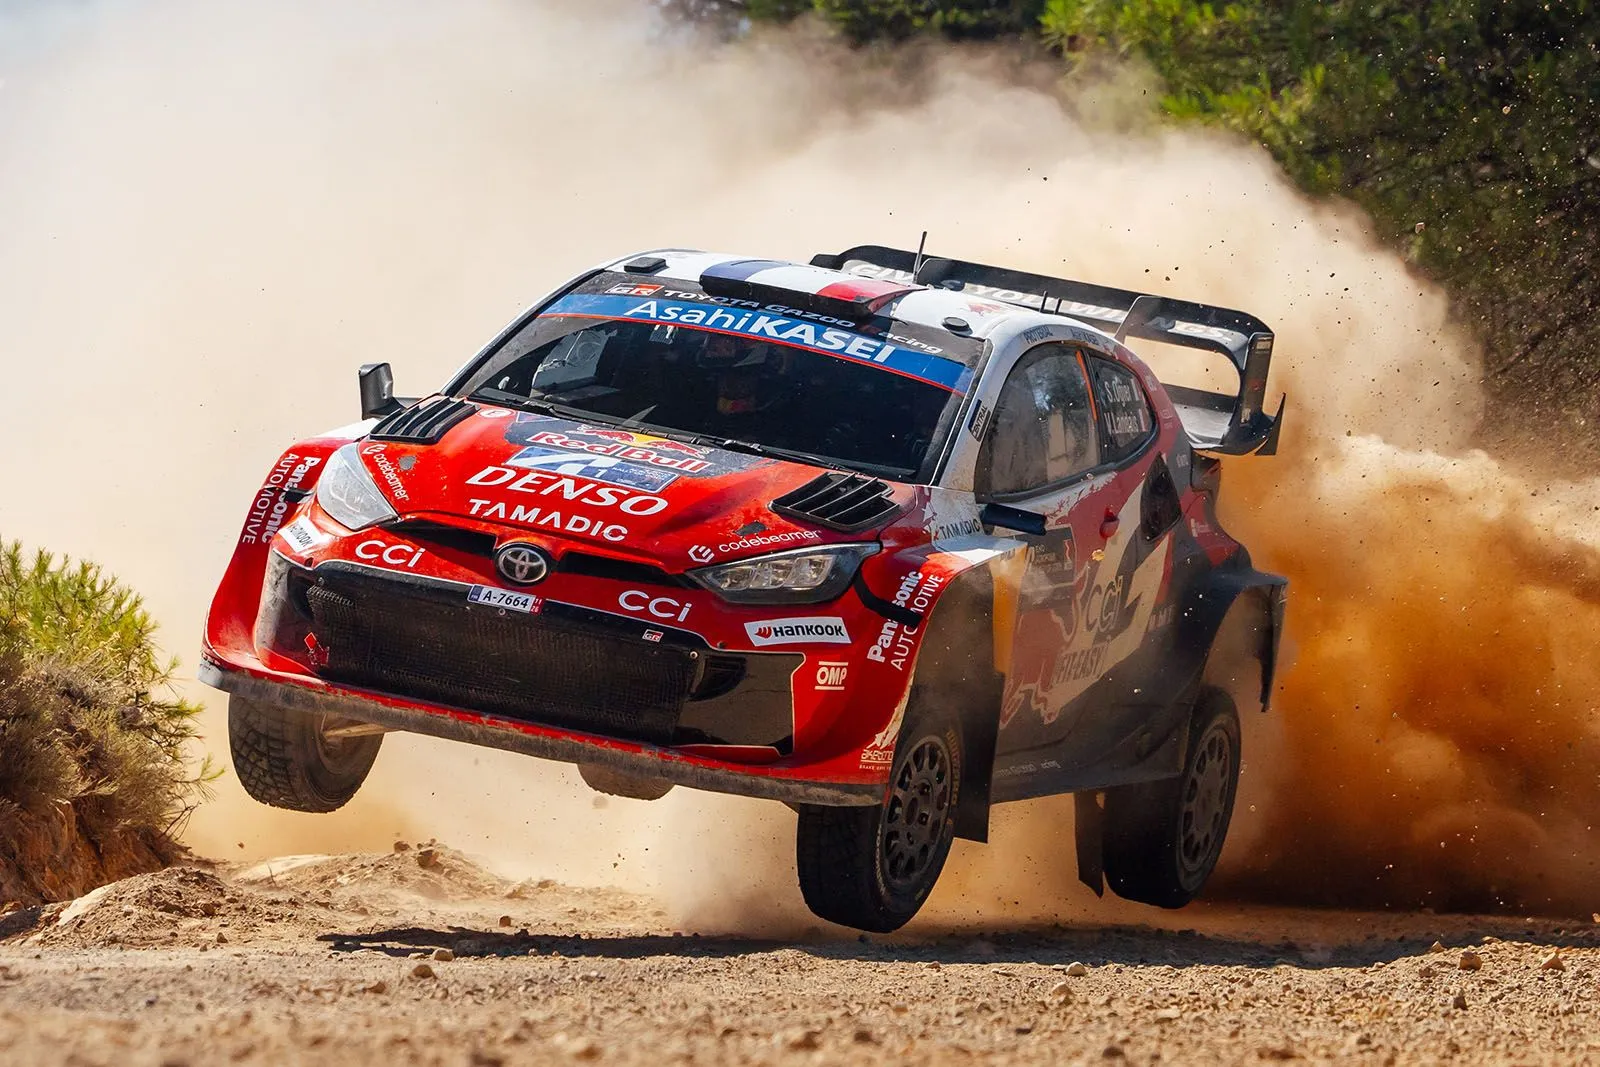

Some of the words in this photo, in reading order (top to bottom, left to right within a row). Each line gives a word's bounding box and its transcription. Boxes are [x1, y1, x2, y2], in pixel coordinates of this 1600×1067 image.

[604, 283, 660, 296] GR
[664, 289, 760, 308] TOYOTA
[765, 304, 855, 328] GAZOO
[624, 301, 896, 363] AsahiKASEI
[526, 432, 626, 456] Red
[616, 448, 713, 473] Bull
[373, 453, 410, 500] codebeamer
[465, 466, 669, 516] DENSO
[468, 498, 628, 541] TAMADIC
[939, 518, 981, 540] TAMADIC
[718, 529, 820, 554] codebeamer
[483, 590, 530, 609] A-7664
[816, 666, 847, 685] OMP
